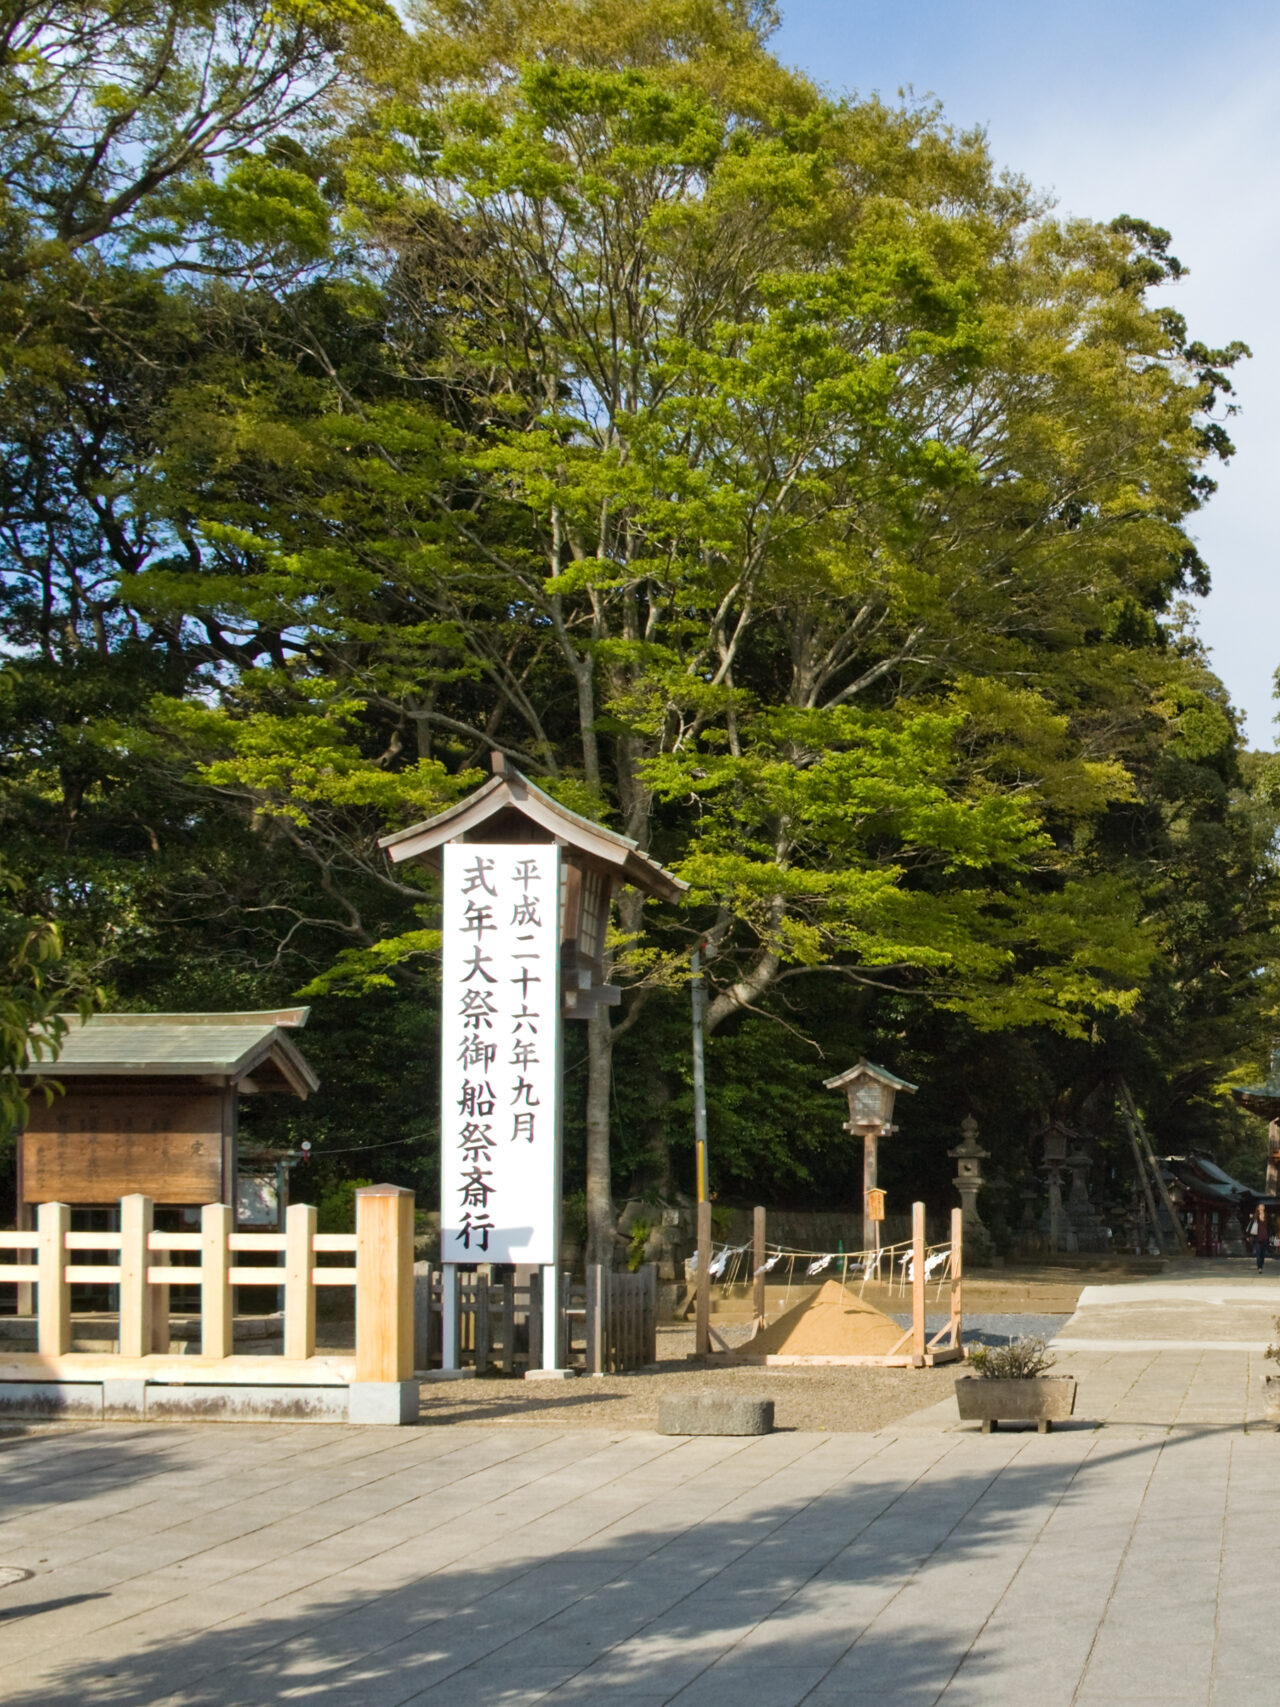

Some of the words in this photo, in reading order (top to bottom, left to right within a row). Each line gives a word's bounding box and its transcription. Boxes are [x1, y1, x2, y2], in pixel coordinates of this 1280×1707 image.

[455, 855, 498, 1252] 式年大祭御船祭斎行
[508, 858, 542, 1144] 平成二十六年九月
